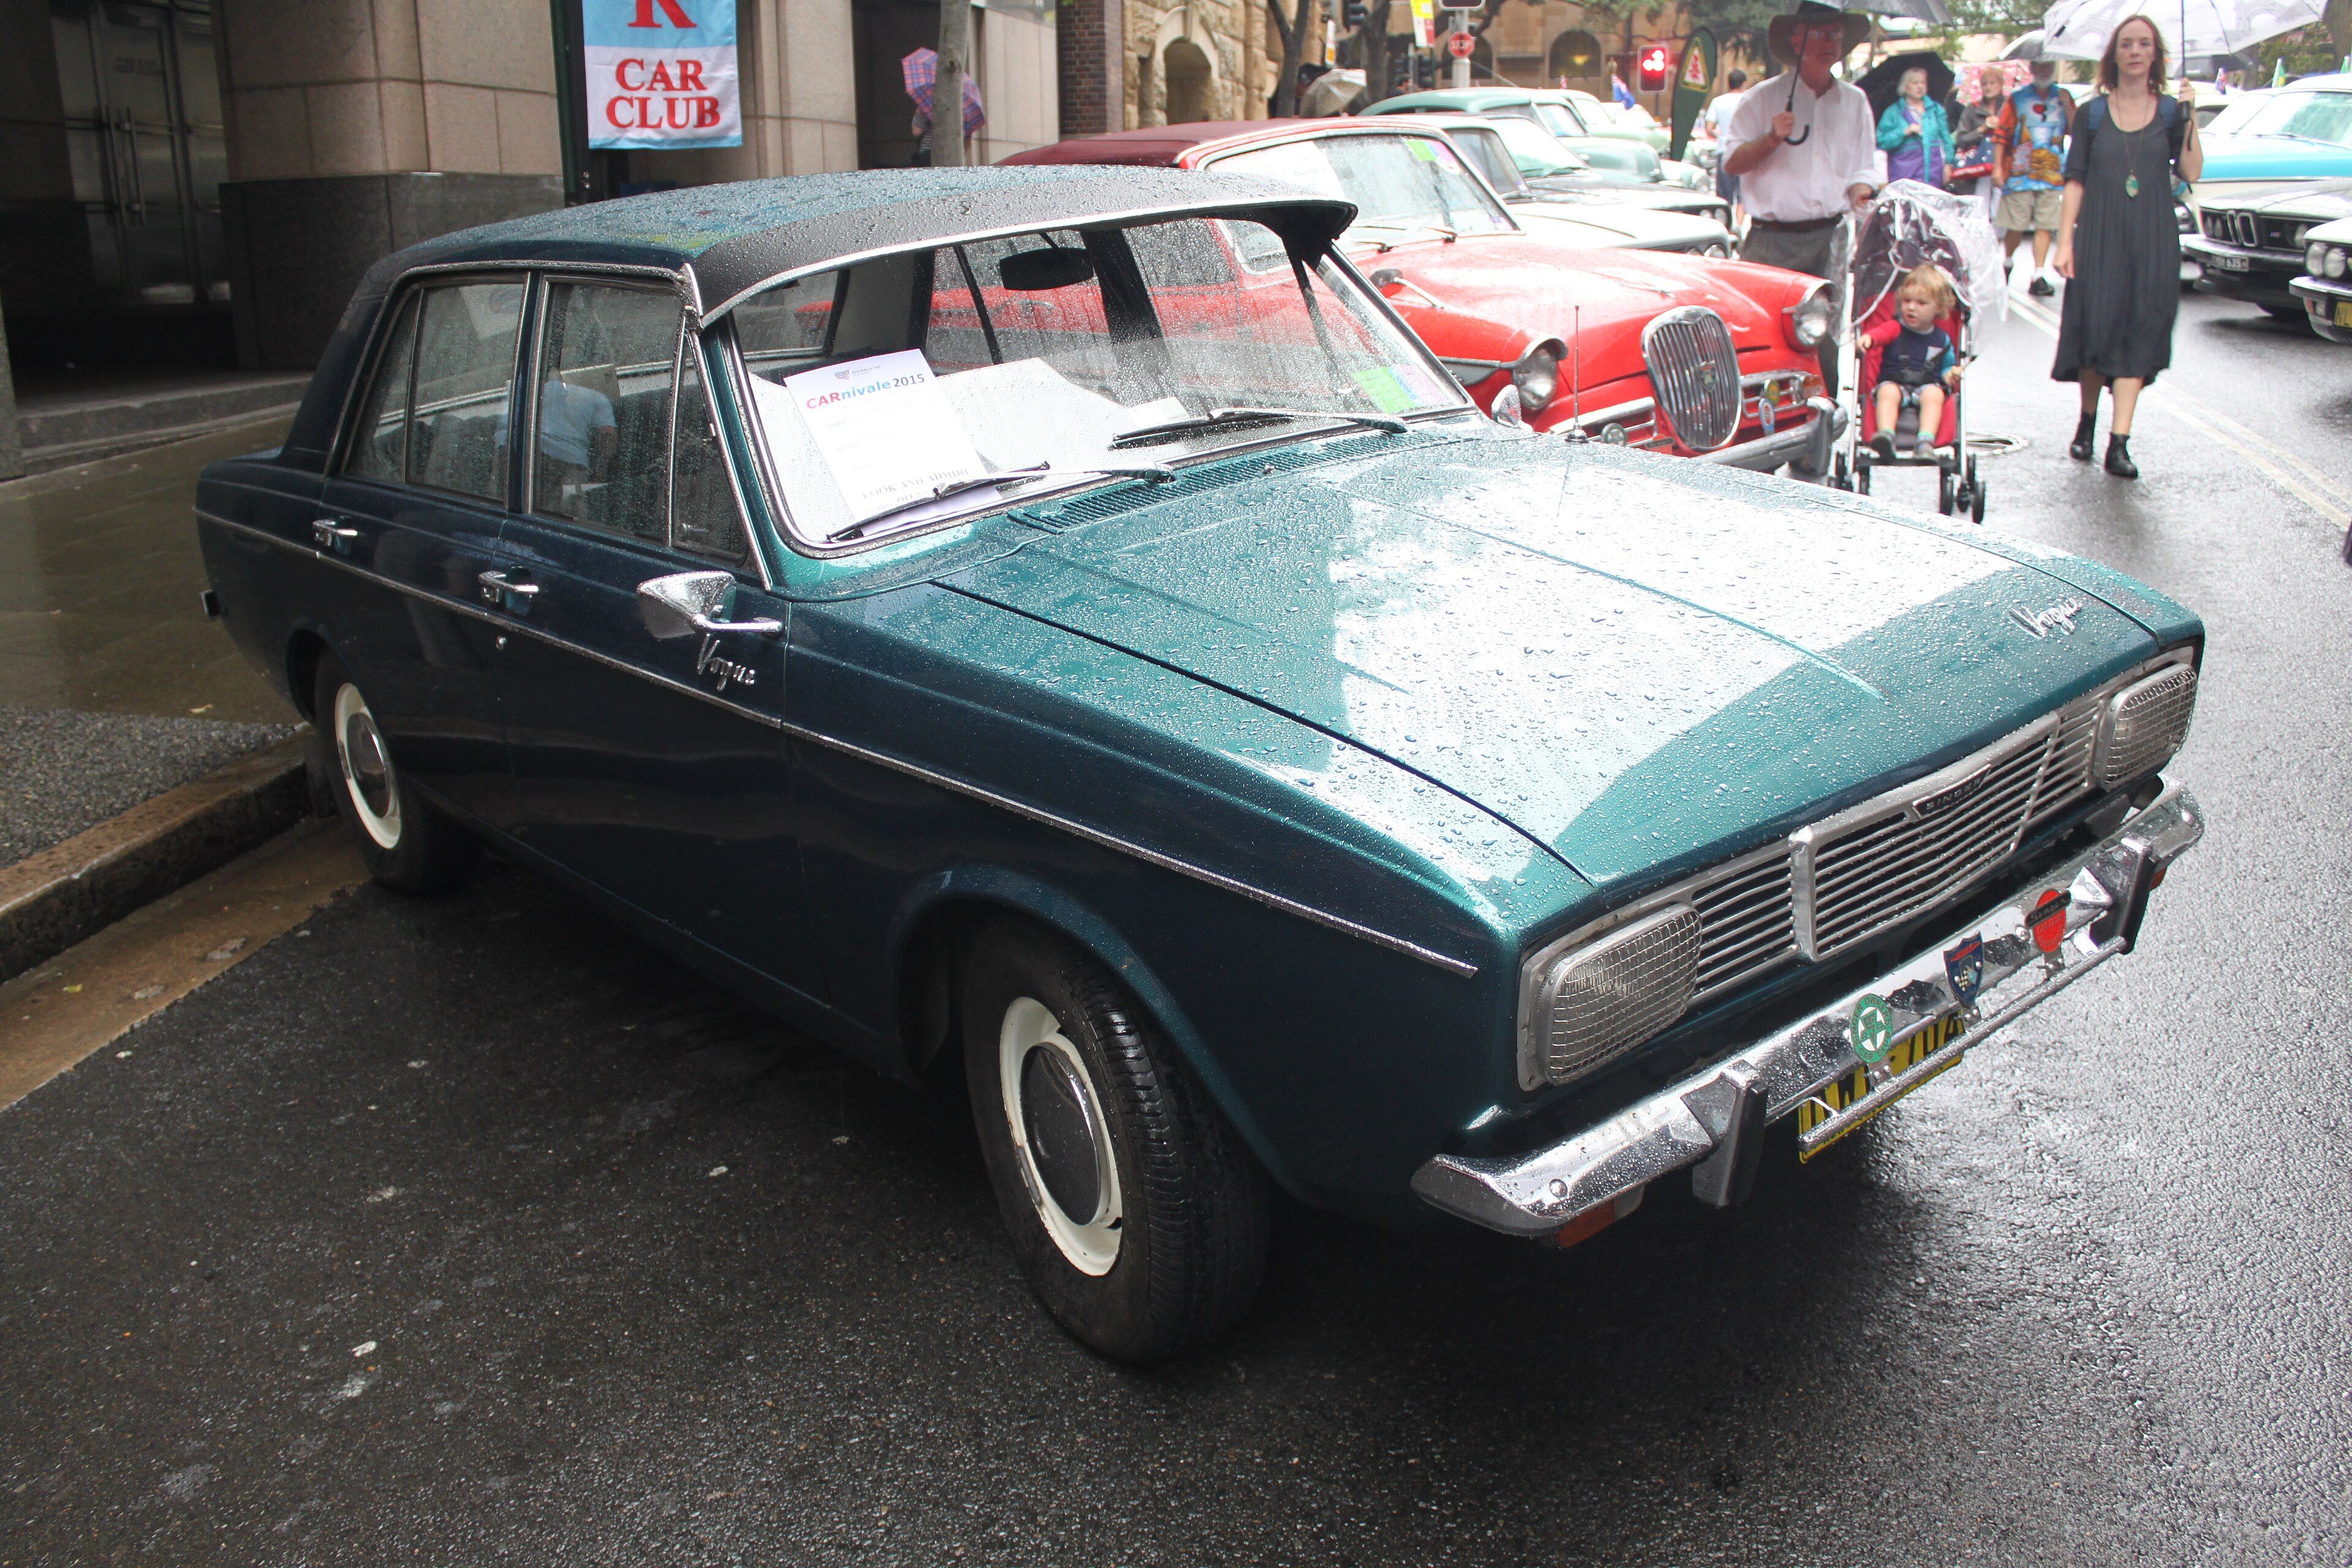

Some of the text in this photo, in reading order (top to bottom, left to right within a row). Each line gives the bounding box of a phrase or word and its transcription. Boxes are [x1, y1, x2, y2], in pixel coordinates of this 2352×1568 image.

[616, 58, 707, 91] CAR
[606, 96, 720, 129] CLUB
[806, 374, 925, 409] CARnivale 2015
[902, 478, 924, 489] AND
[929, 468, 968, 481] ADMIRE
[1926, 777, 1983, 810] SINGER
